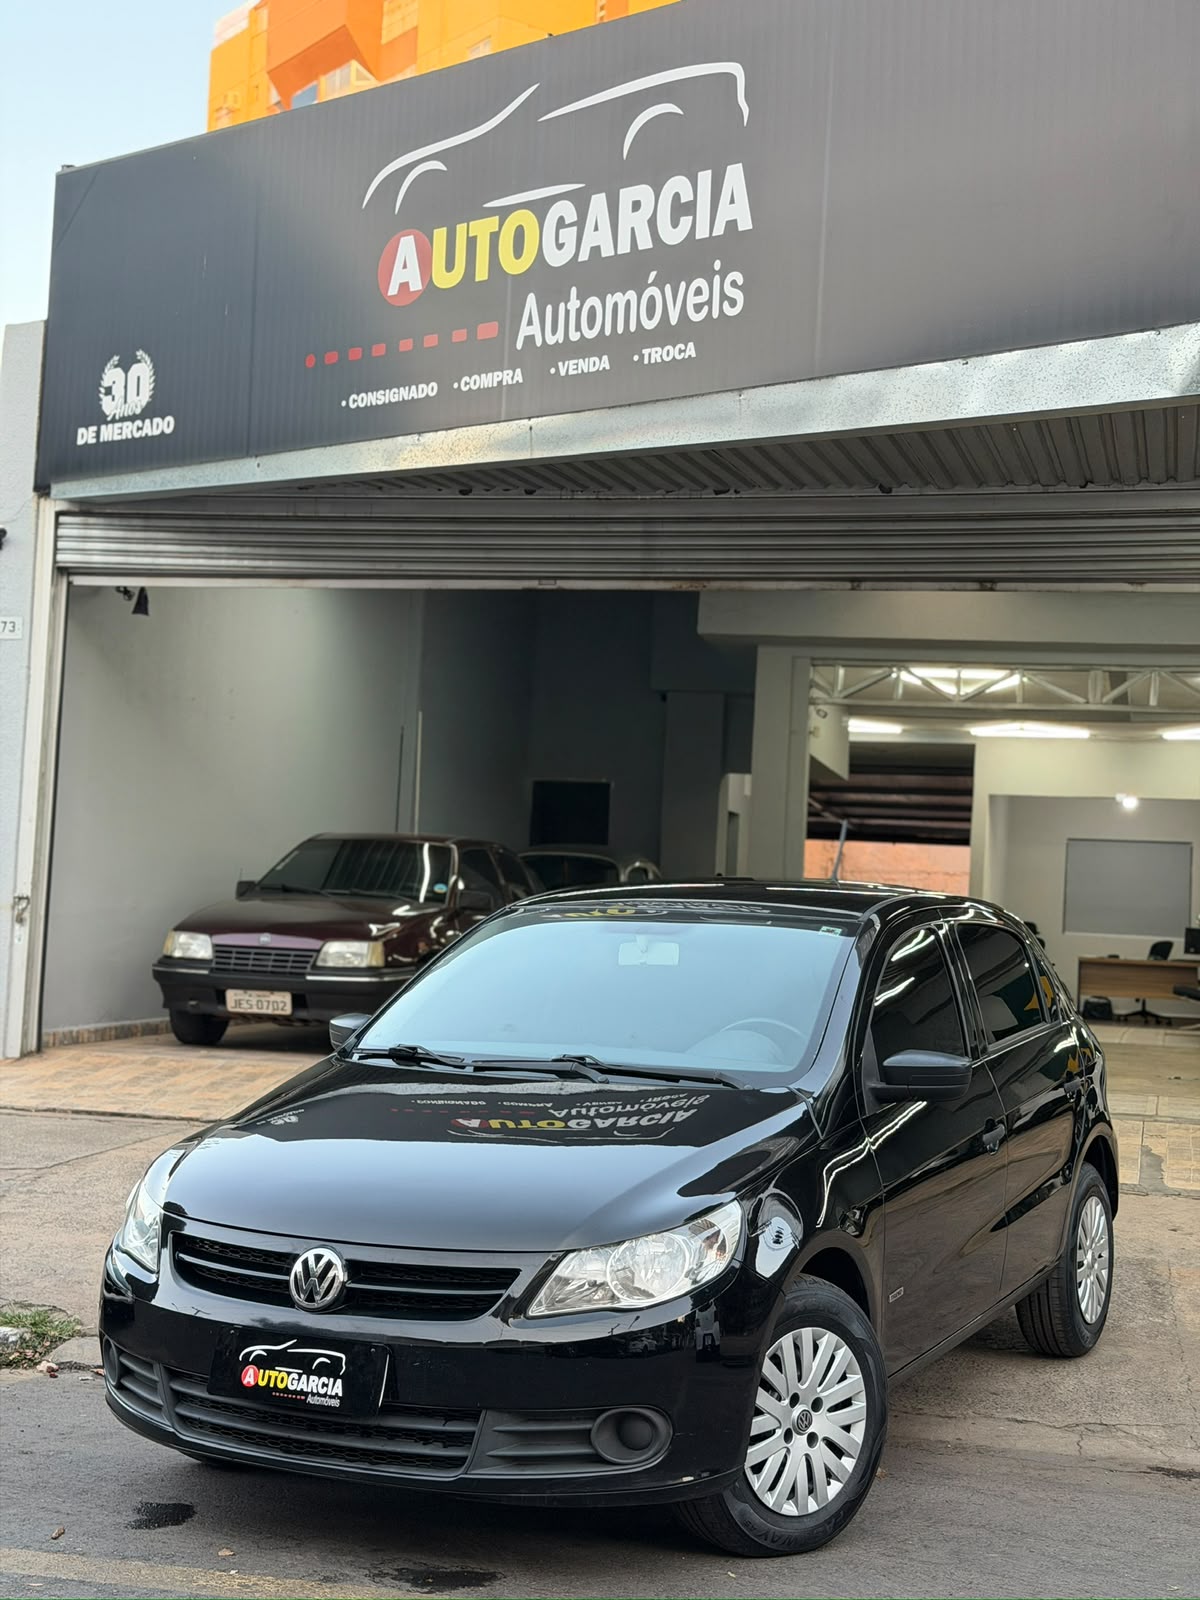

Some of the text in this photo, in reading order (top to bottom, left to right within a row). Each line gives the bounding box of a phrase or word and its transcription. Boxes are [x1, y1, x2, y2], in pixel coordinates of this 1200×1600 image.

[386, 162, 753, 297] AUTOGARCIA
[516, 260, 744, 350] Automóveis
[101, 362, 150, 416] 30
[348, 342, 696, 409] CONSIGNADO COMPRA VENDA TROCA
[76, 416, 175, 445] DE MERCADO
[242, 1368, 343, 1397] AUTOGARCIA
[306, 1394, 341, 1408] Automóveis
